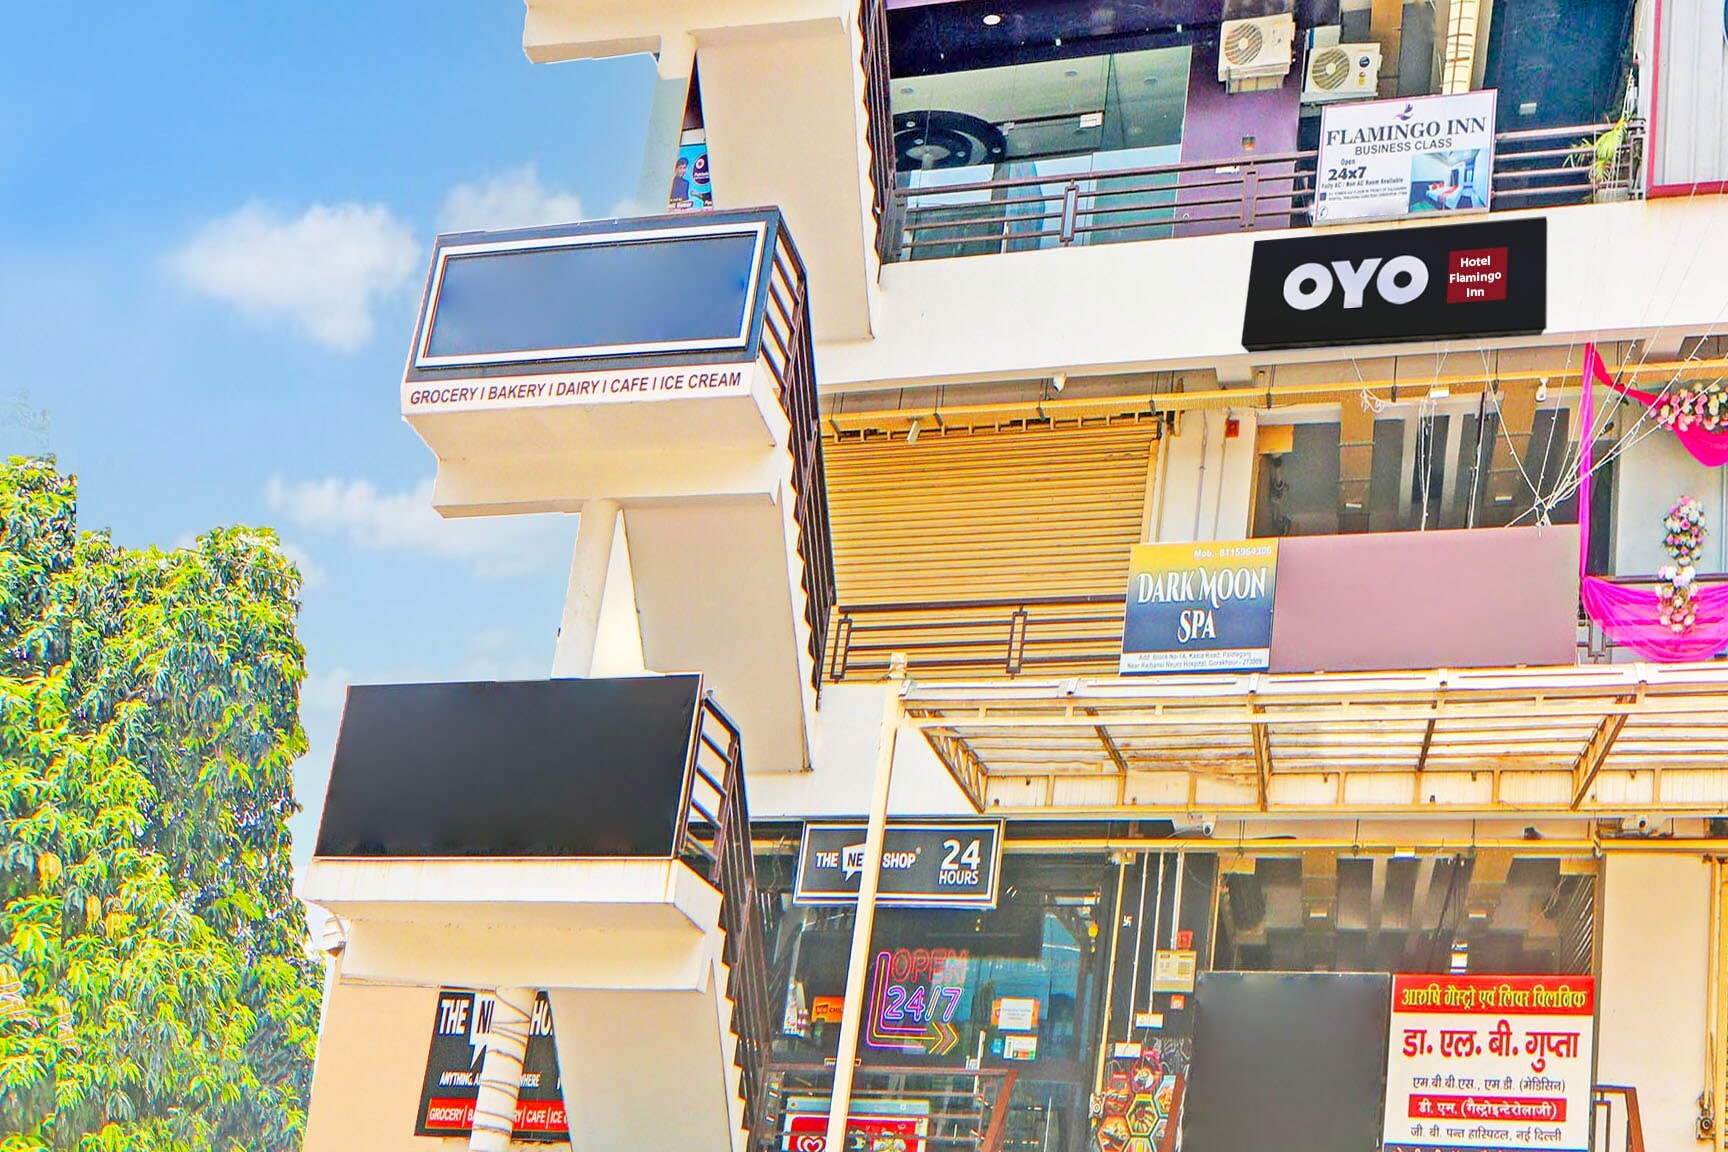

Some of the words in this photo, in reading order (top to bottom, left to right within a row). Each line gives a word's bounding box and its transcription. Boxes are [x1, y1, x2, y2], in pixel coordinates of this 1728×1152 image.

[1326, 120, 1440, 146] FLAMINGO
[1447, 117, 1487, 135] INN
[1355, 141, 1411, 156] BUSINESS
[1414, 138, 1453, 150] CLASS
[1328, 166, 1367, 181] 24x7
[1340, 158, 1355, 166] Open
[1460, 256, 1490, 268] Hotel
[1283, 255, 1429, 310] OYO
[1450, 270, 1502, 284] Flamingo
[1467, 287, 1484, 297] Inn
[410, 386, 478, 404] GROCERY
[488, 383, 546, 400] BAKERY
[556, 380, 600, 395] DAIRY
[610, 377, 648, 393] CAFE
[660, 375, 684, 389] ICE
[688, 372, 741, 388] CREAM
[1137, 570, 1195, 603] DARK
[1199, 567, 1267, 608] MOON
[1177, 610, 1216, 643] SPA
[816, 852, 840, 868] THE
[847, 852, 865, 867] NE
[882, 852, 916, 869] SHOP
[941, 838, 981, 870] 24
[939, 870, 979, 885] HOURS
[890, 948, 969, 984] OPEN
[885, 985, 962, 1023] 24/7
[1478, 986, 1497, 1009] एवं
[1499, 984, 1530, 1007] लिवर
[439, 999, 470, 1035] THE
[1403, 1029, 1433, 1057] डा.
[1440, 1030, 1481, 1057] एल.
[1488, 1019, 1518, 1057] बी.
[1525, 1031, 1580, 1073] गुप्ता
[429, 1107, 464, 1122] GROCERY
[526, 1109, 546, 1123] CAFE
[550, 1110, 563, 1124] ICE
[1534, 1126, 1561, 1141] दिल्ली
